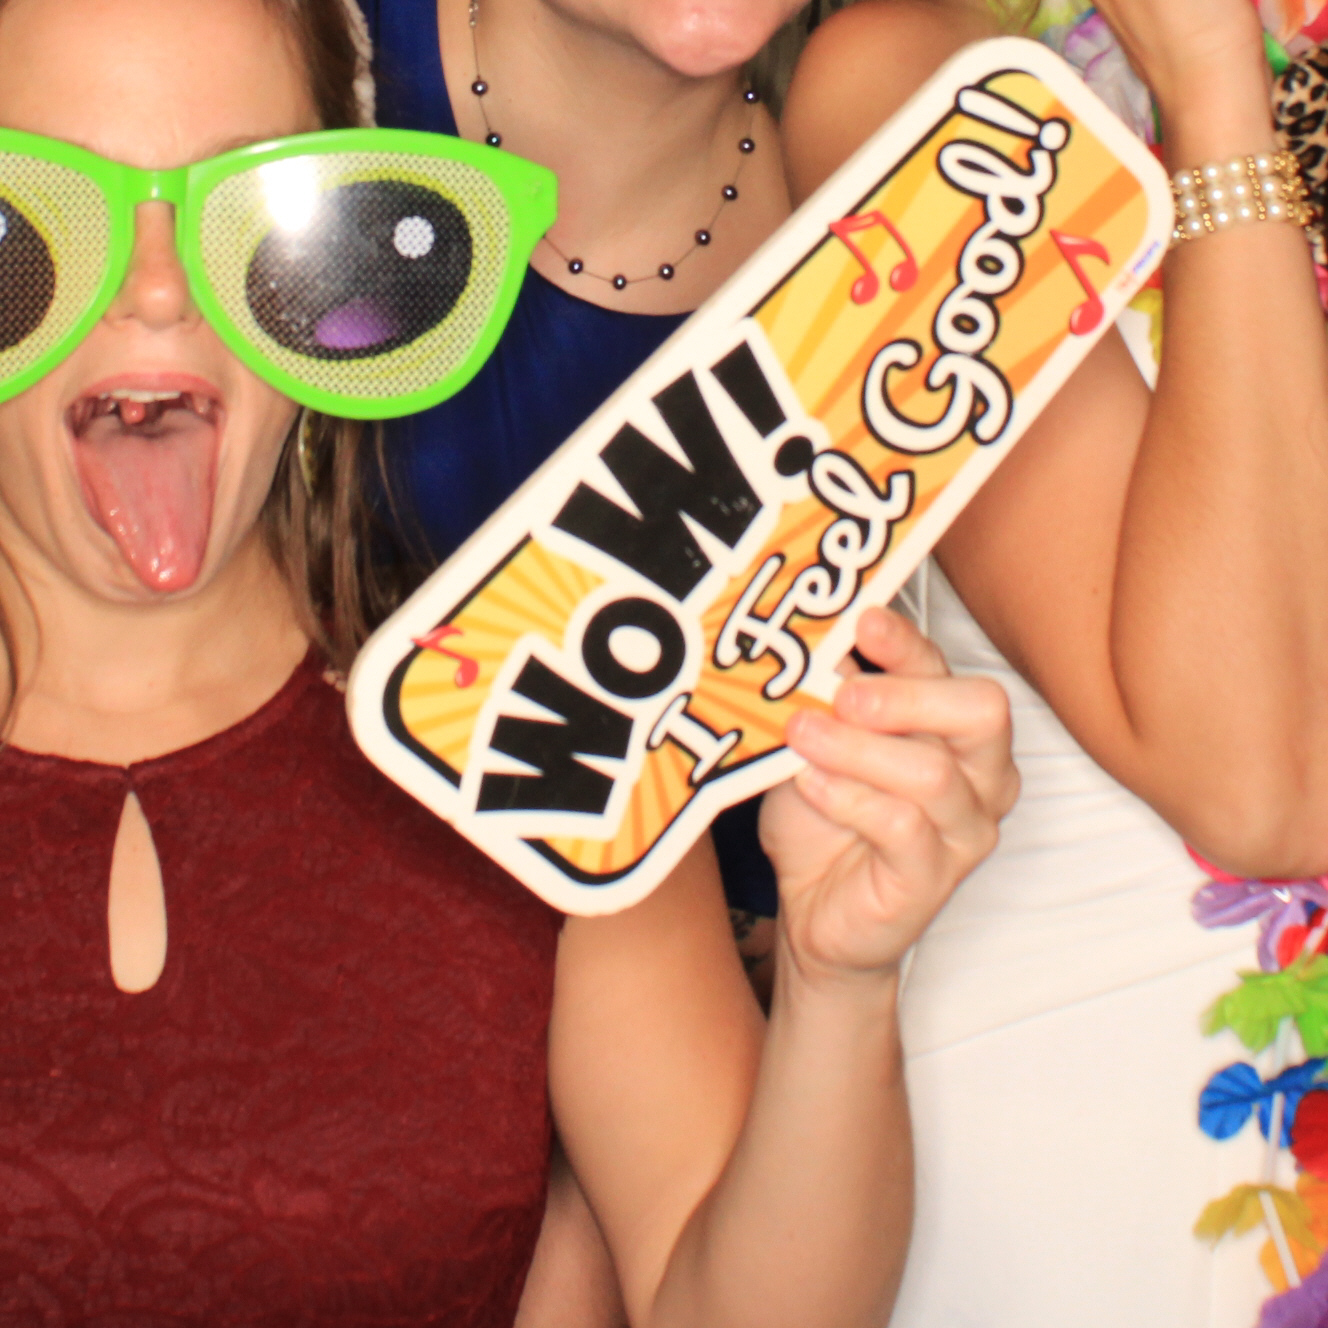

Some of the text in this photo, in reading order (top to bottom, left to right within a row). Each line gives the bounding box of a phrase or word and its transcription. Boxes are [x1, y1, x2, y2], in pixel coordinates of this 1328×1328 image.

[475, 340, 815, 815] WOW!
[646, 85, 1073, 789] I Feel Good!
